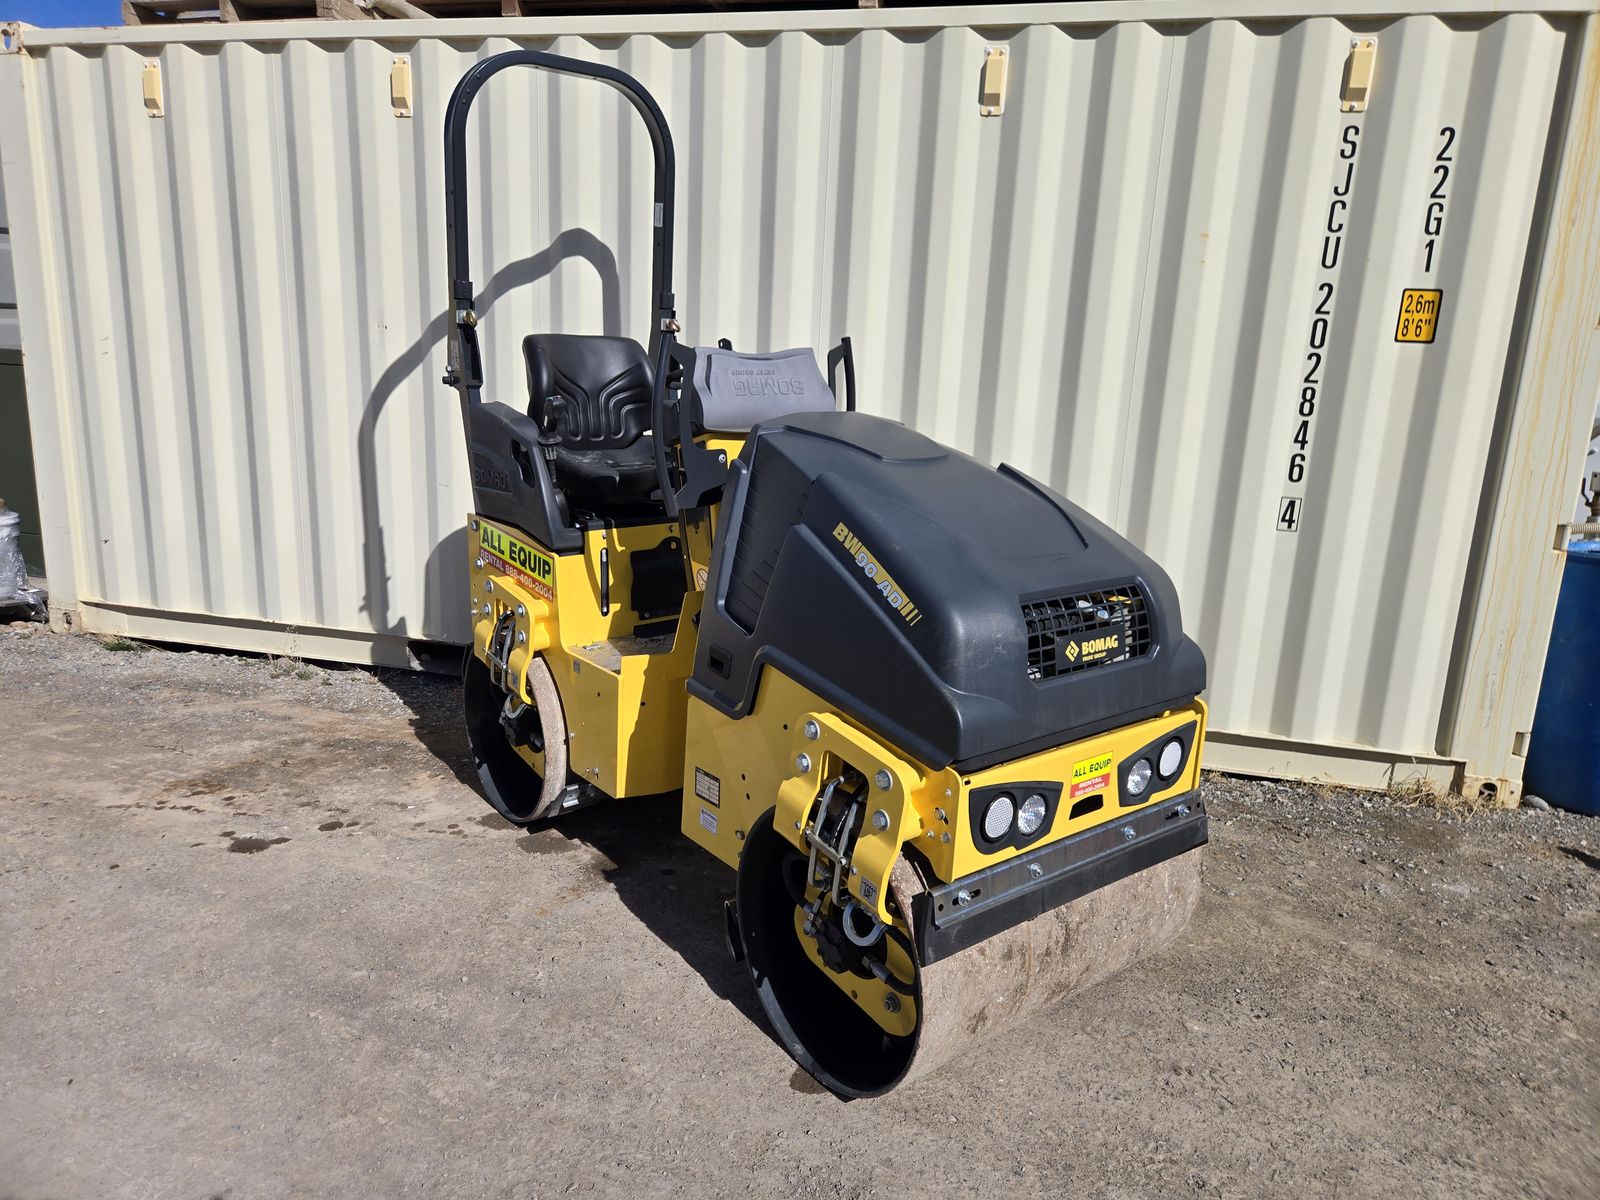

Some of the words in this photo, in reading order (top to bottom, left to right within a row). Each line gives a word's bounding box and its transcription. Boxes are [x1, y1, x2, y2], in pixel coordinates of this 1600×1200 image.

[1320, 125, 1360, 269] SJCU
[1423, 126, 1457, 273] 22G1
[1404, 294, 1436, 318] 2,6m
[733, 377, 805, 397] BOMAG
[1287, 282, 1334, 483] 202846
[1280, 499, 1296, 529] 4
[482, 526, 505, 556] ALL
[509, 540, 552, 580] EQUIP
[480, 549, 504, 571] RENTAL
[505, 564, 553, 600] 888-400-2004
[1081, 634, 1119, 655] BOMAG
[1073, 766, 1087, 778] ALL
[1089, 758, 1111, 773] EQUIP
